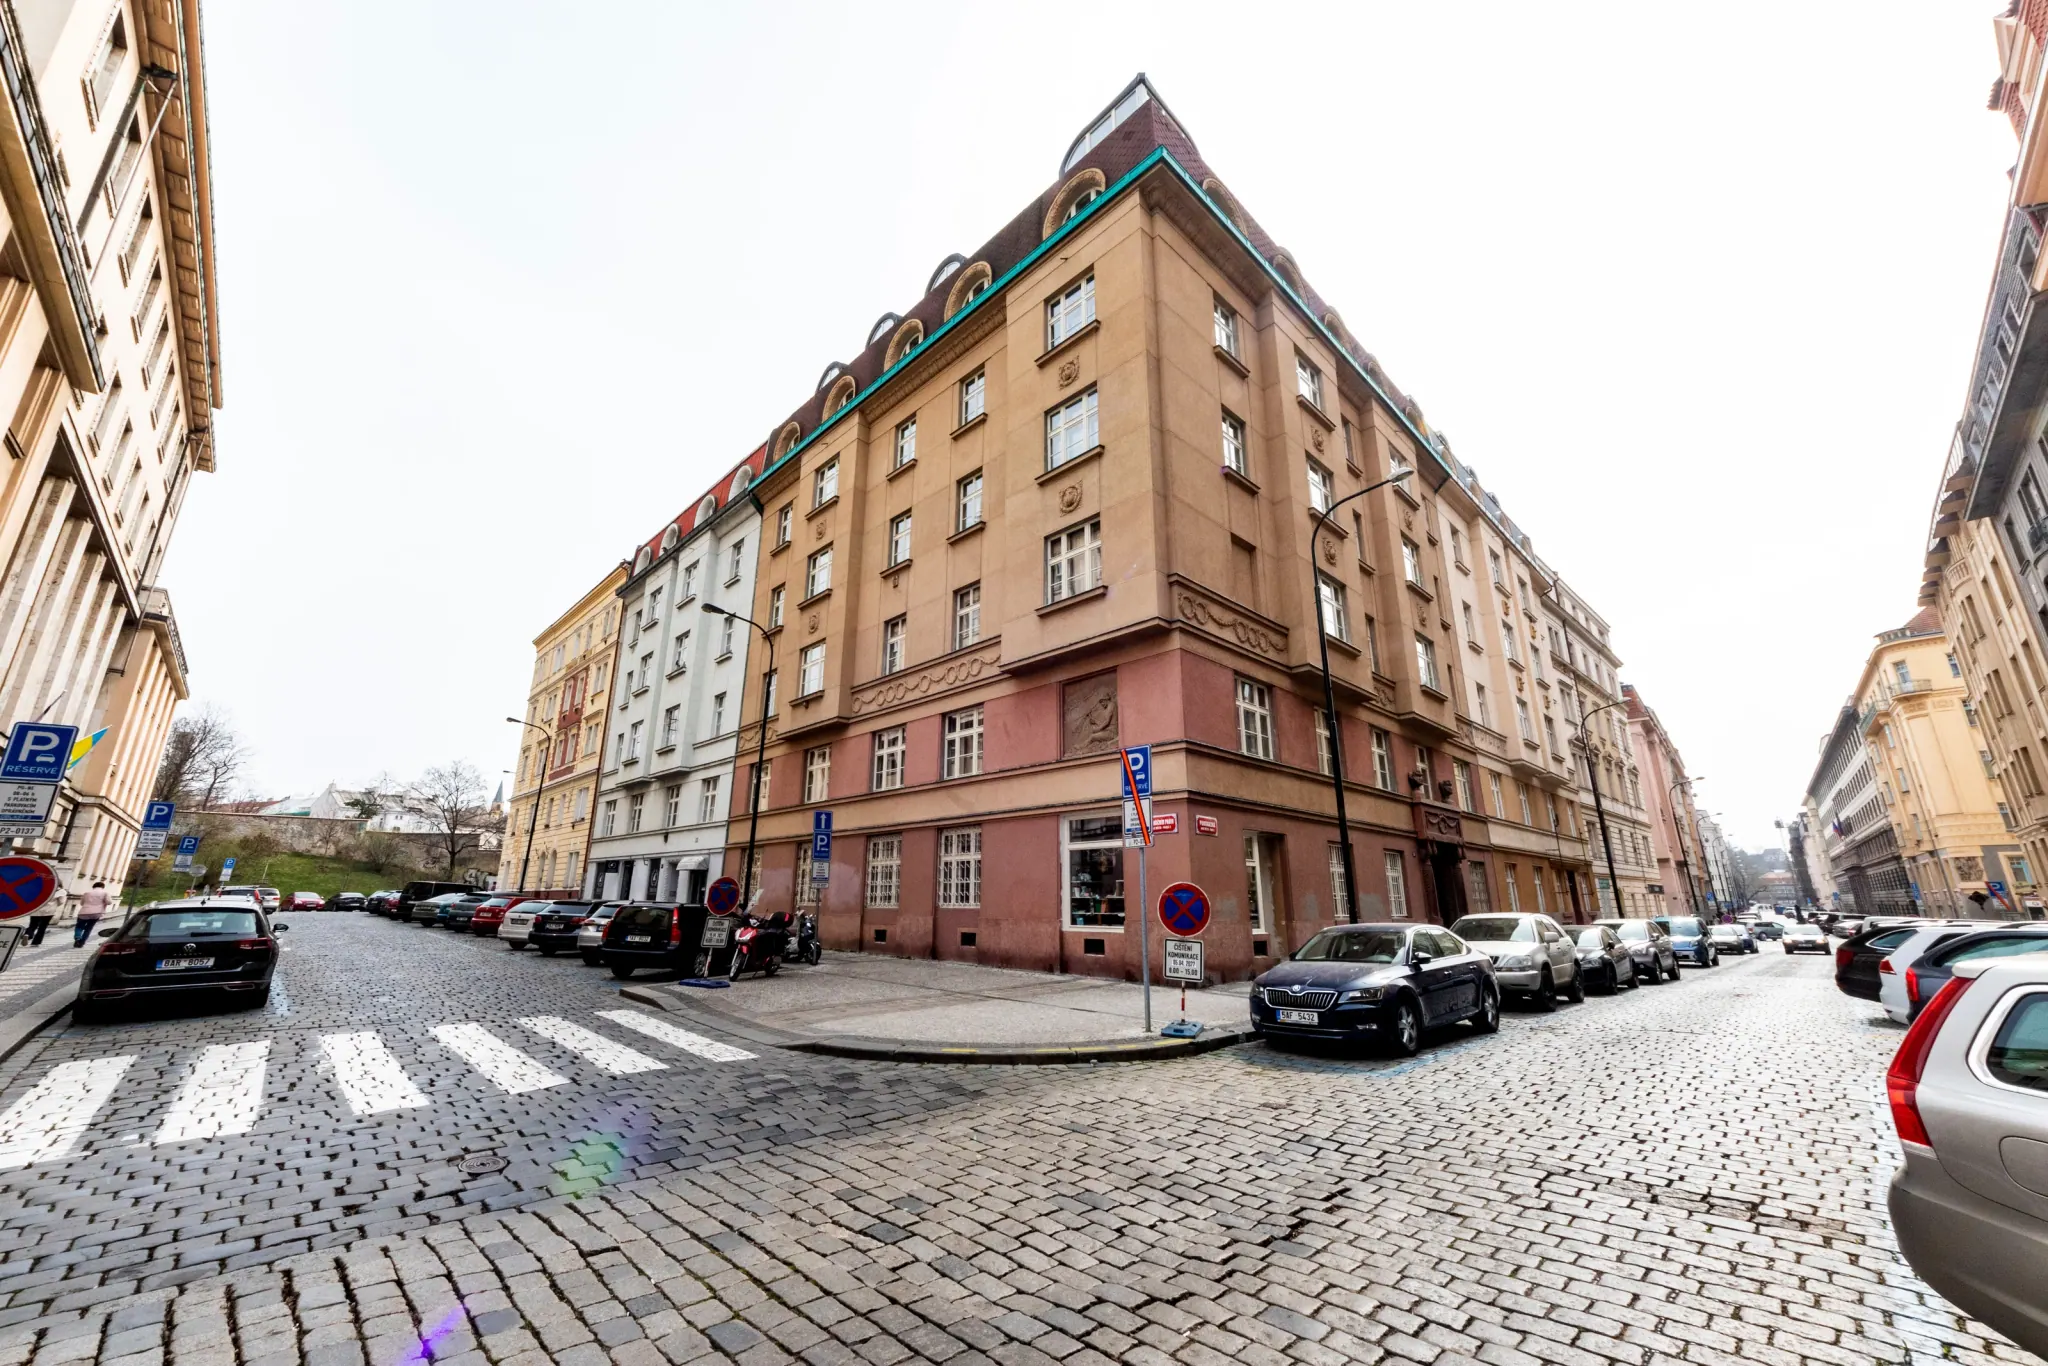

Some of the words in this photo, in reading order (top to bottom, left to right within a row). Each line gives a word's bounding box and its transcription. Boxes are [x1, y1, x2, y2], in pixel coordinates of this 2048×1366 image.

[18, 730, 60, 762] P
[6, 764, 59, 775] RÉSERVÉ
[150, 805, 169, 821] P
[817, 835, 828, 851] P
[1167, 951, 1199, 960] KOMUNIKACE
[1297, 1012, 1316, 1022] 5432
